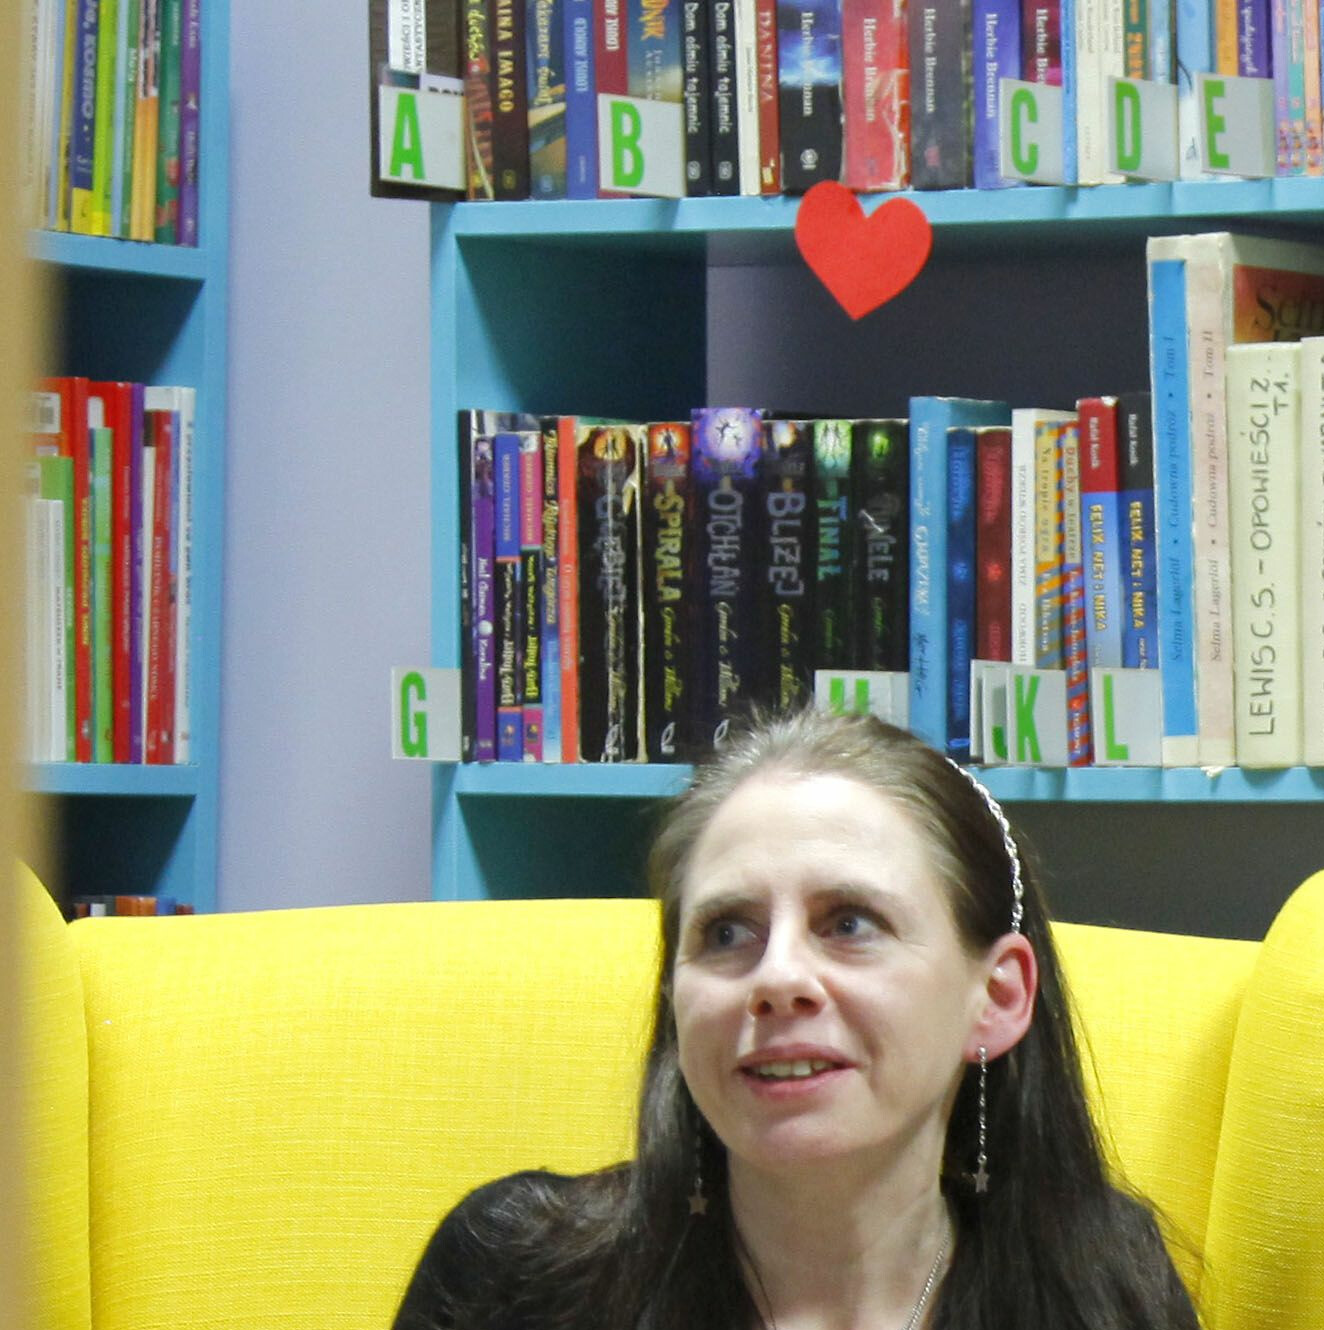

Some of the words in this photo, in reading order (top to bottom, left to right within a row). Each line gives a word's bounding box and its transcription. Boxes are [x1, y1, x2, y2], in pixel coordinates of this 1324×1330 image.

[684, 2, 699, 30] Dom
[715, 2, 729, 30] Dom
[863, 18, 876, 61] Herbie
[924, 8, 936, 53] Herbie
[985, 13, 997, 59] Herbie
[682, 76, 700, 133] tajemnic
[712, 76, 730, 133] tajemnic
[925, 57, 936, 113] Brennan
[985, 62, 997, 118] Brennan
[389, 92, 426, 180] A
[611, 101, 644, 188] B
[1011, 88, 1039, 175] C
[1114, 81, 1142, 171] D
[1202, 79, 1230, 169] E
[1163, 347, 1176, 381] Tom
[1203, 344, 1215, 377] Tom
[1165, 469, 1180, 528] Cudowna
[1205, 464, 1218, 528] Cudowna
[1240, 403, 1271, 551] OPOWIEŚCI
[655, 493, 685, 604] SPIRALA
[1093, 551, 1104, 580] NET
[1093, 595, 1107, 632] NIKA
[1171, 619, 1186, 661] Selma
[1209, 619, 1222, 661] Selma
[400, 671, 429, 758] G
[1013, 674, 1042, 763] K
[1102, 673, 1129, 761] L
[1249, 647, 1275, 736] LEWIS
